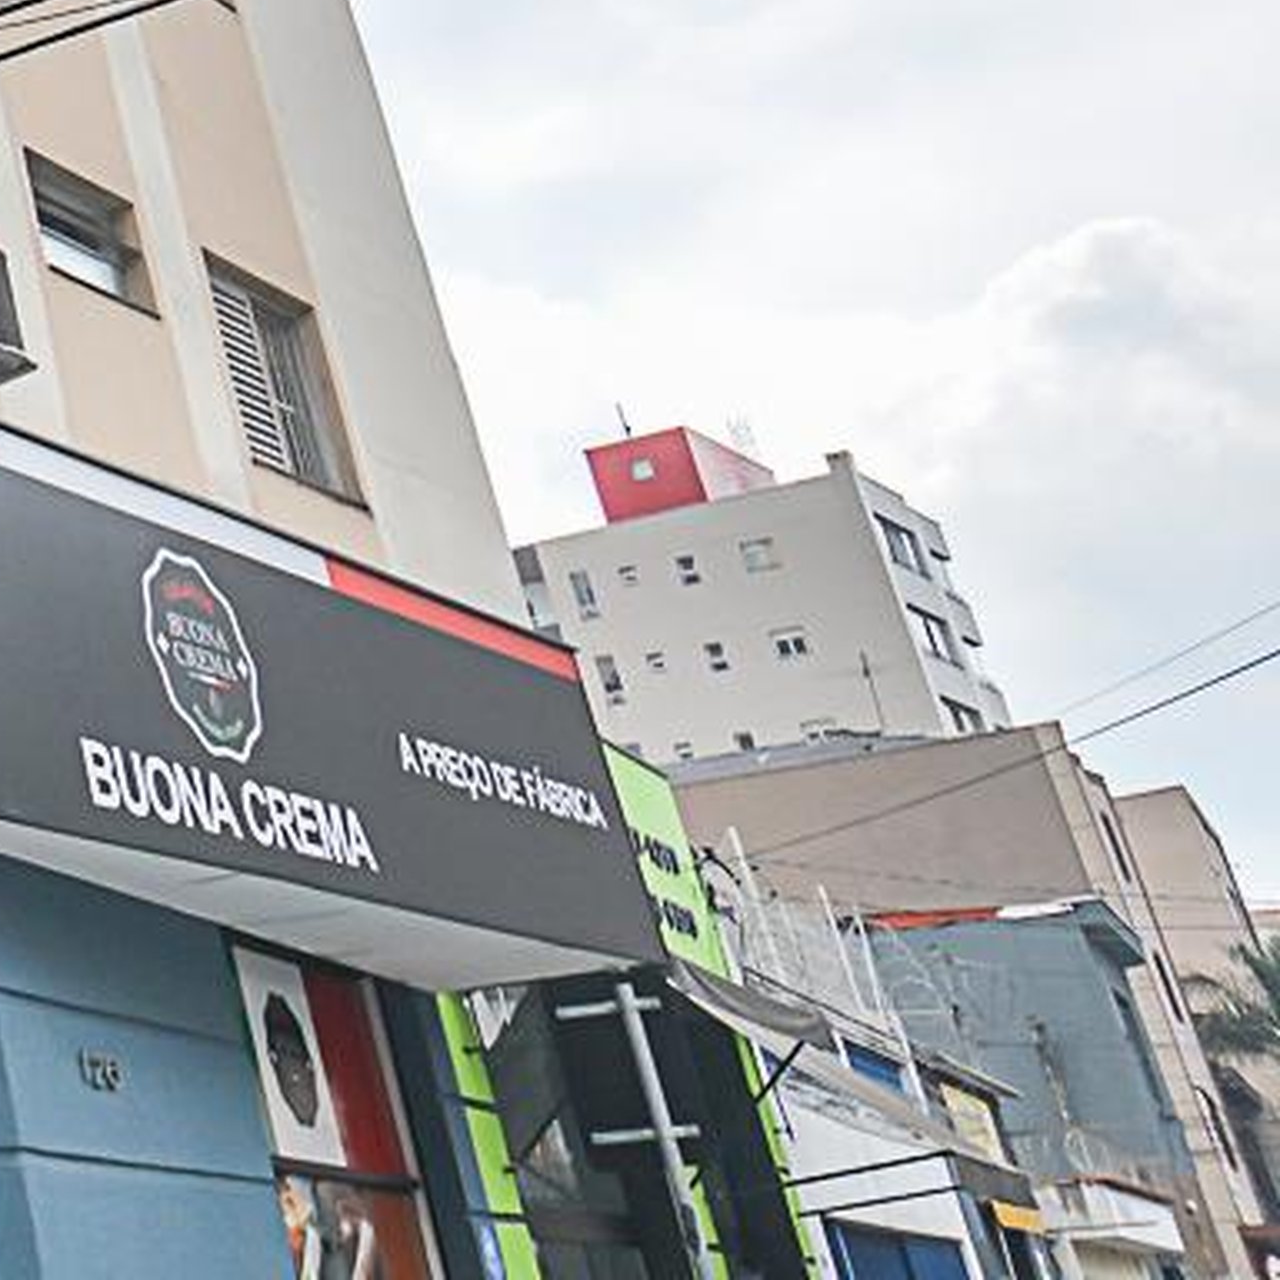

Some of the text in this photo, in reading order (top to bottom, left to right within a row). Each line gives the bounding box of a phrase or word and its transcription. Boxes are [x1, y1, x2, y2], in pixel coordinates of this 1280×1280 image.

[80, 736, 380, 873] BUONA CREMA
[398, 732, 609, 830] A PREÇO DE FÁBRICA
